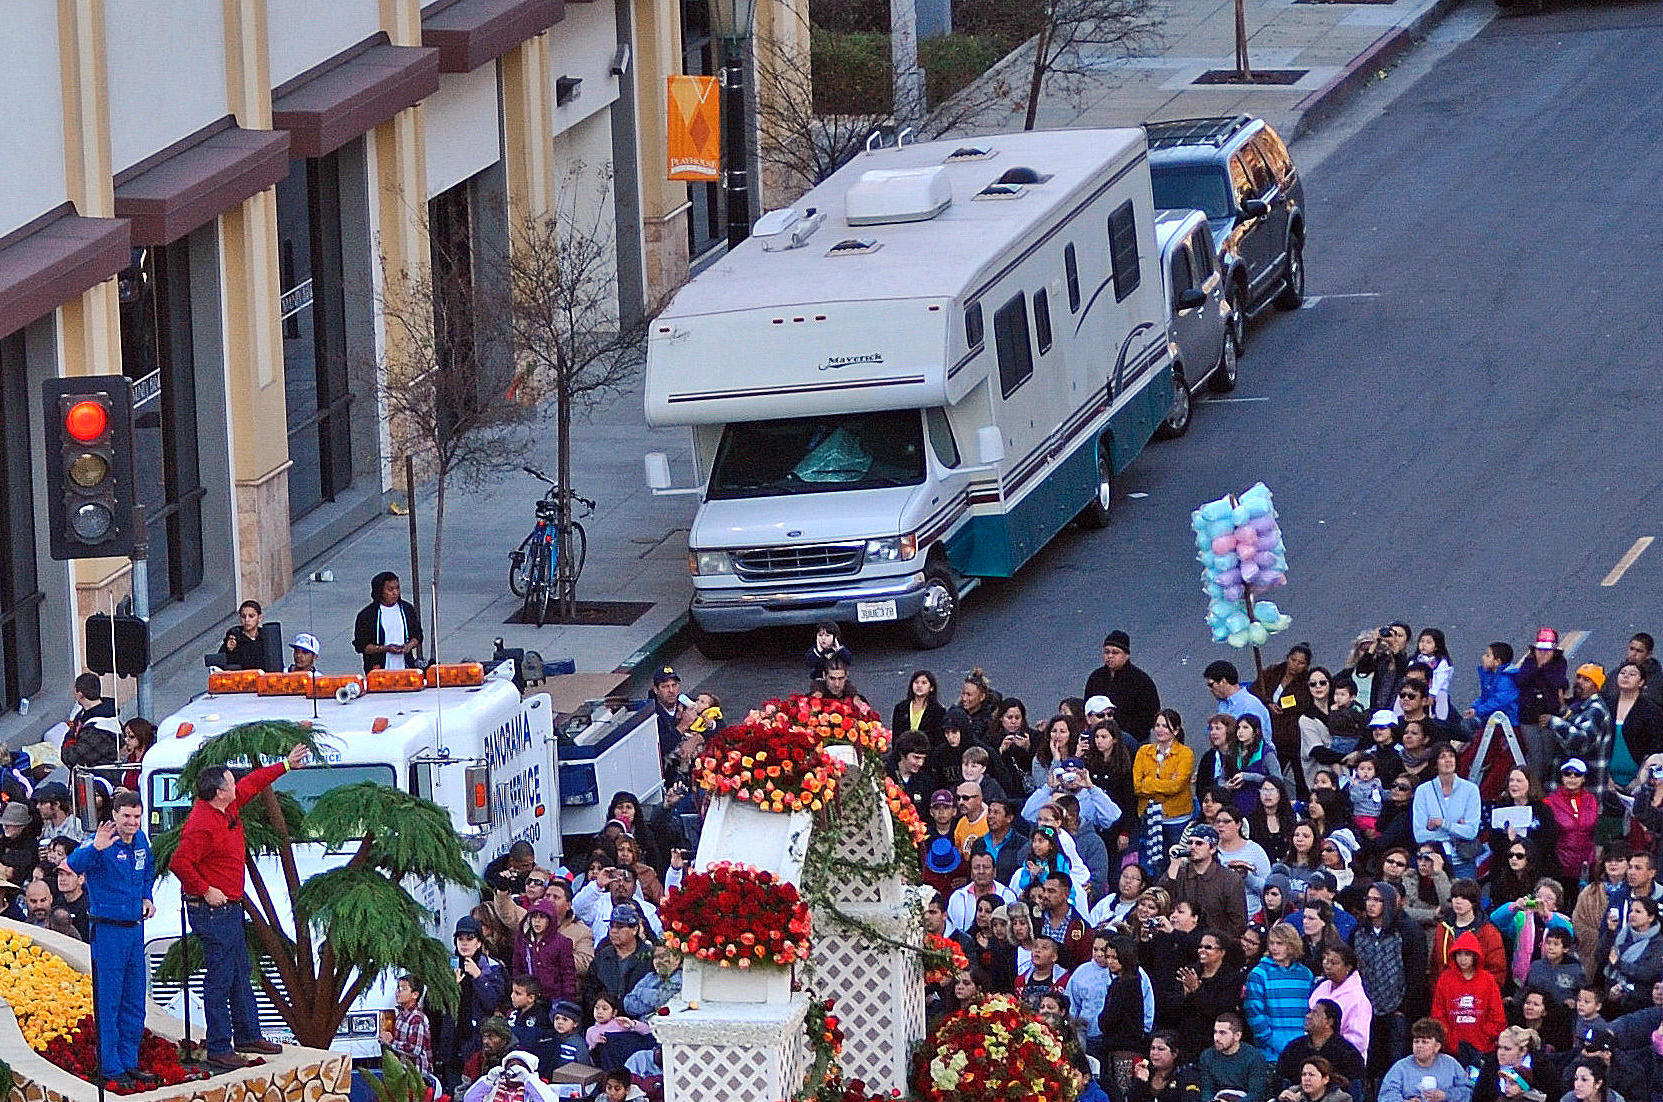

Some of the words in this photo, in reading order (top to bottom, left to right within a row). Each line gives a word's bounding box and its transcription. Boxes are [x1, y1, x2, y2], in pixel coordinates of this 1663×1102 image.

[828, 352, 883, 364] Maverick
[484, 711, 532, 771] PANORAMA
[509, 764, 541, 819] SERVICE
